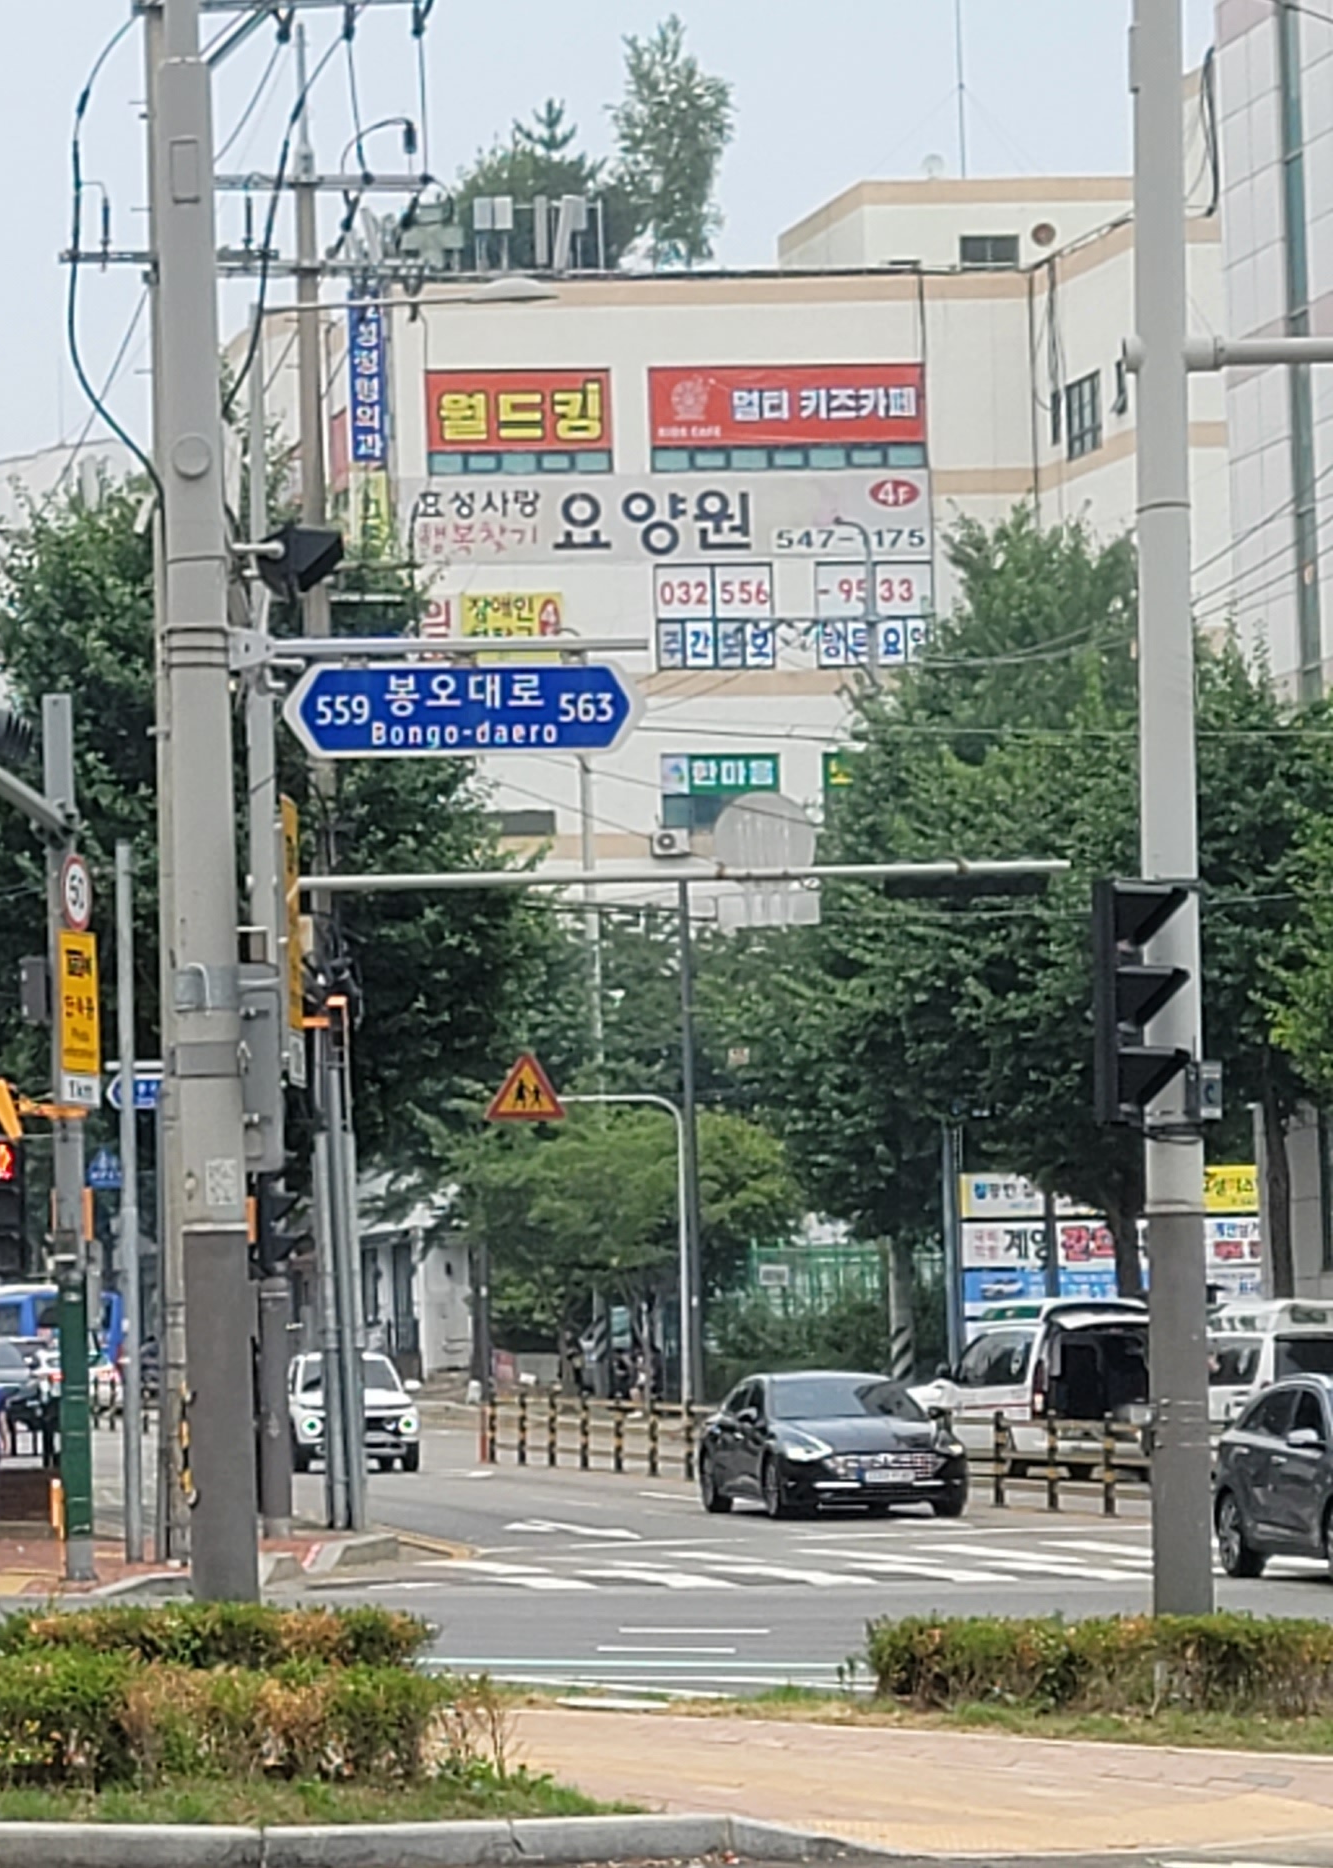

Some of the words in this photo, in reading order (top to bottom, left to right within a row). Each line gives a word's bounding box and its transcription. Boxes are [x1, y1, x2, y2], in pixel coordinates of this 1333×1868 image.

[438, 381, 604, 442] 월드킹
[732, 388, 789, 421] 멀티
[799, 386, 917, 420] 키즈카페
[877, 483, 912, 505] 4F
[553, 491, 752, 555] 요양원
[776, 529, 925, 549] 547-175
[660, 581, 708, 605] 032
[720, 580, 769, 605] 556
[385, 673, 545, 717] 봉오대로
[557, 693, 614, 722] 563
[314, 698, 370, 727] 559
[371, 722, 557, 749] Bongo-daero
